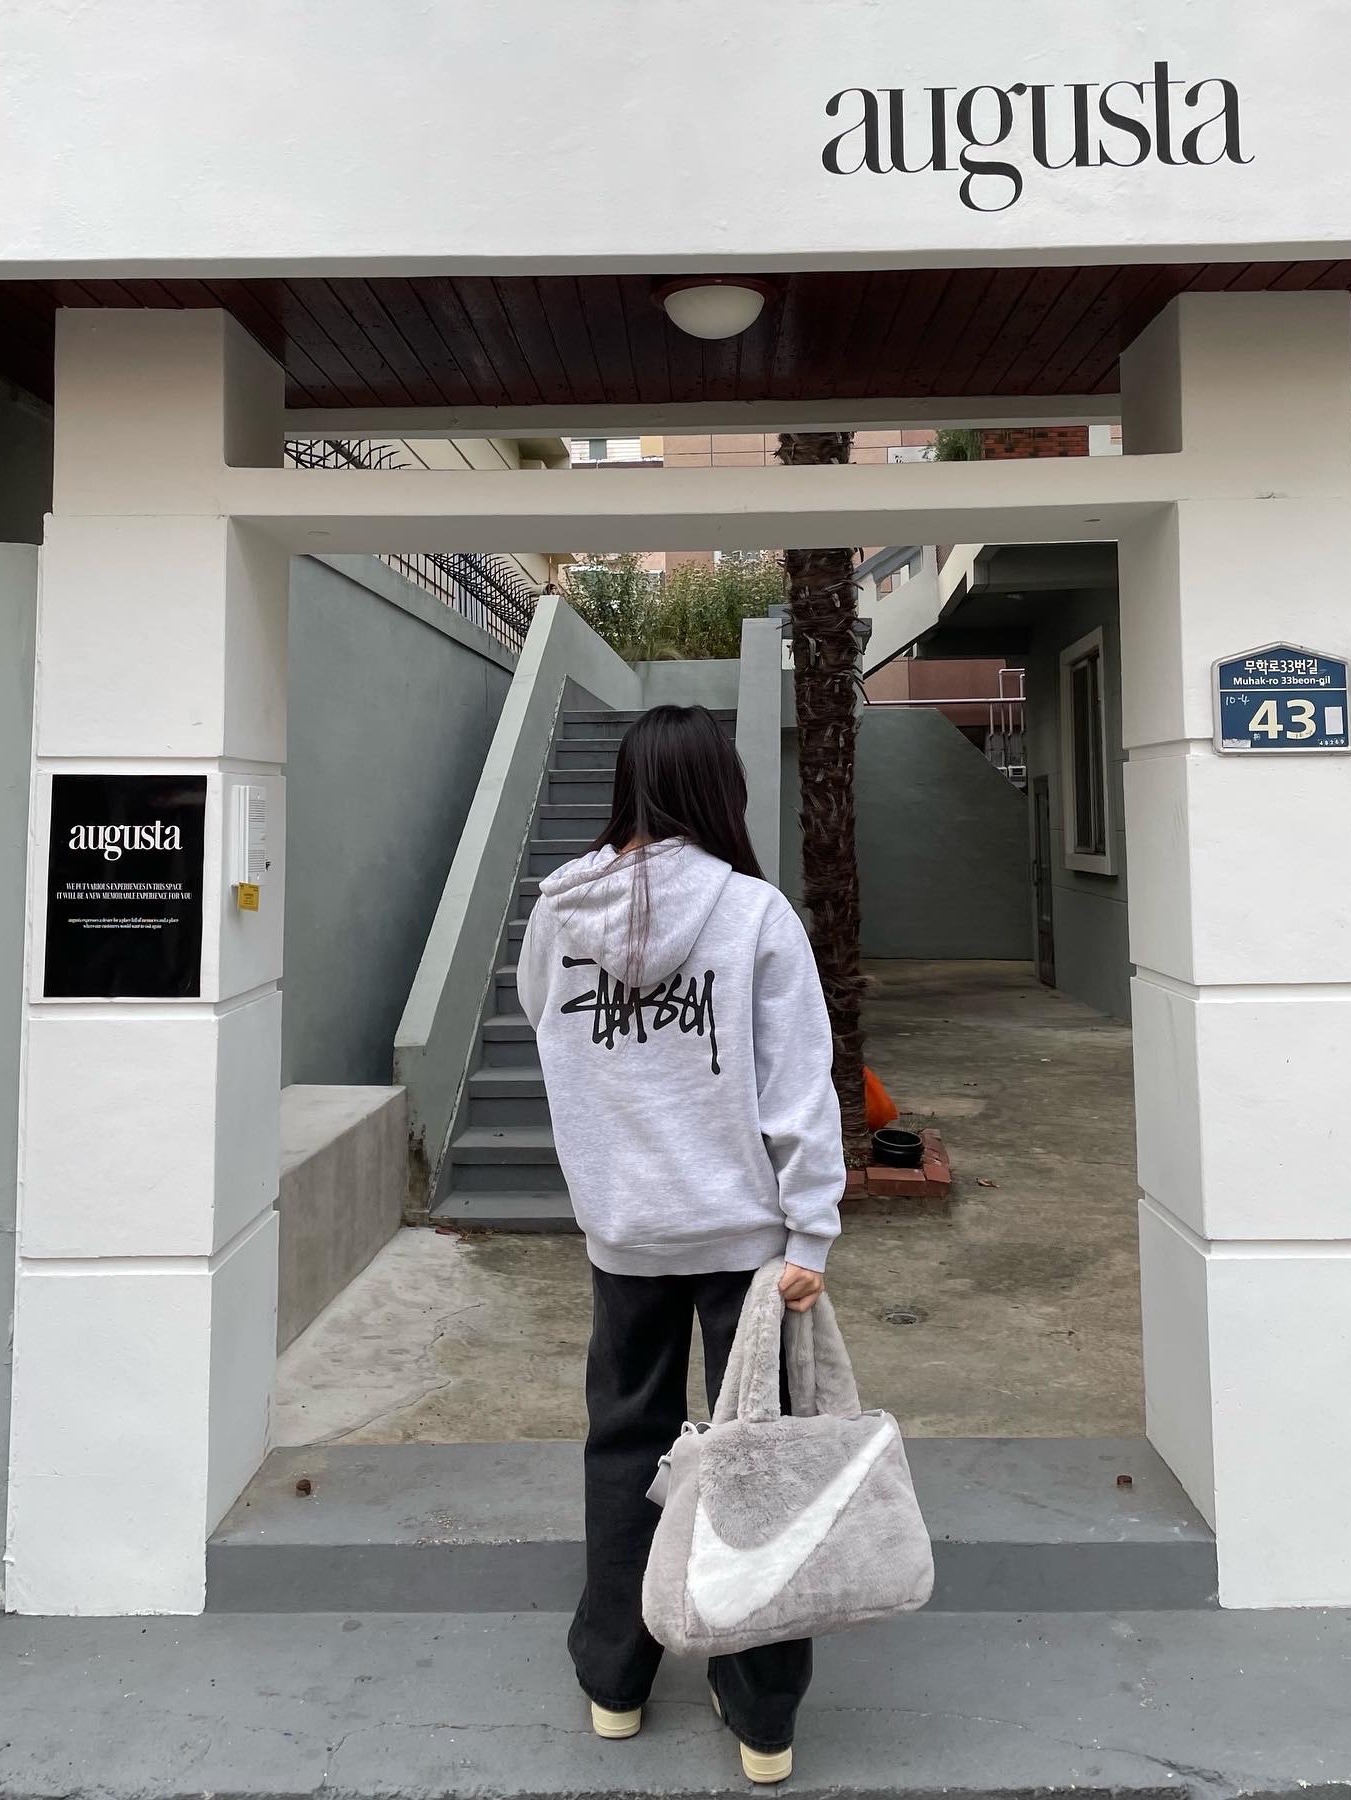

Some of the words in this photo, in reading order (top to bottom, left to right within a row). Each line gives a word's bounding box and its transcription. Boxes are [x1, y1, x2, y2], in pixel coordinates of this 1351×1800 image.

[822, 61, 1255, 212] augusta
[1244, 659, 1318, 675] 무학로33번길
[1233, 677, 1279, 686] Muhak-ro
[1281, 676, 1331, 687] 33beon-gil
[1248, 699, 1316, 740] 43
[69, 820, 183, 861] augusta
[110, 882, 146, 891] EXPERIENCES
[153, 882, 165, 891] THIS
[166, 882, 183, 891] SPACE
[102, 891, 136, 900] MEMORABLE
[136, 891, 168, 900] EXPERIENCE
[168, 891, 180, 900] FOR
